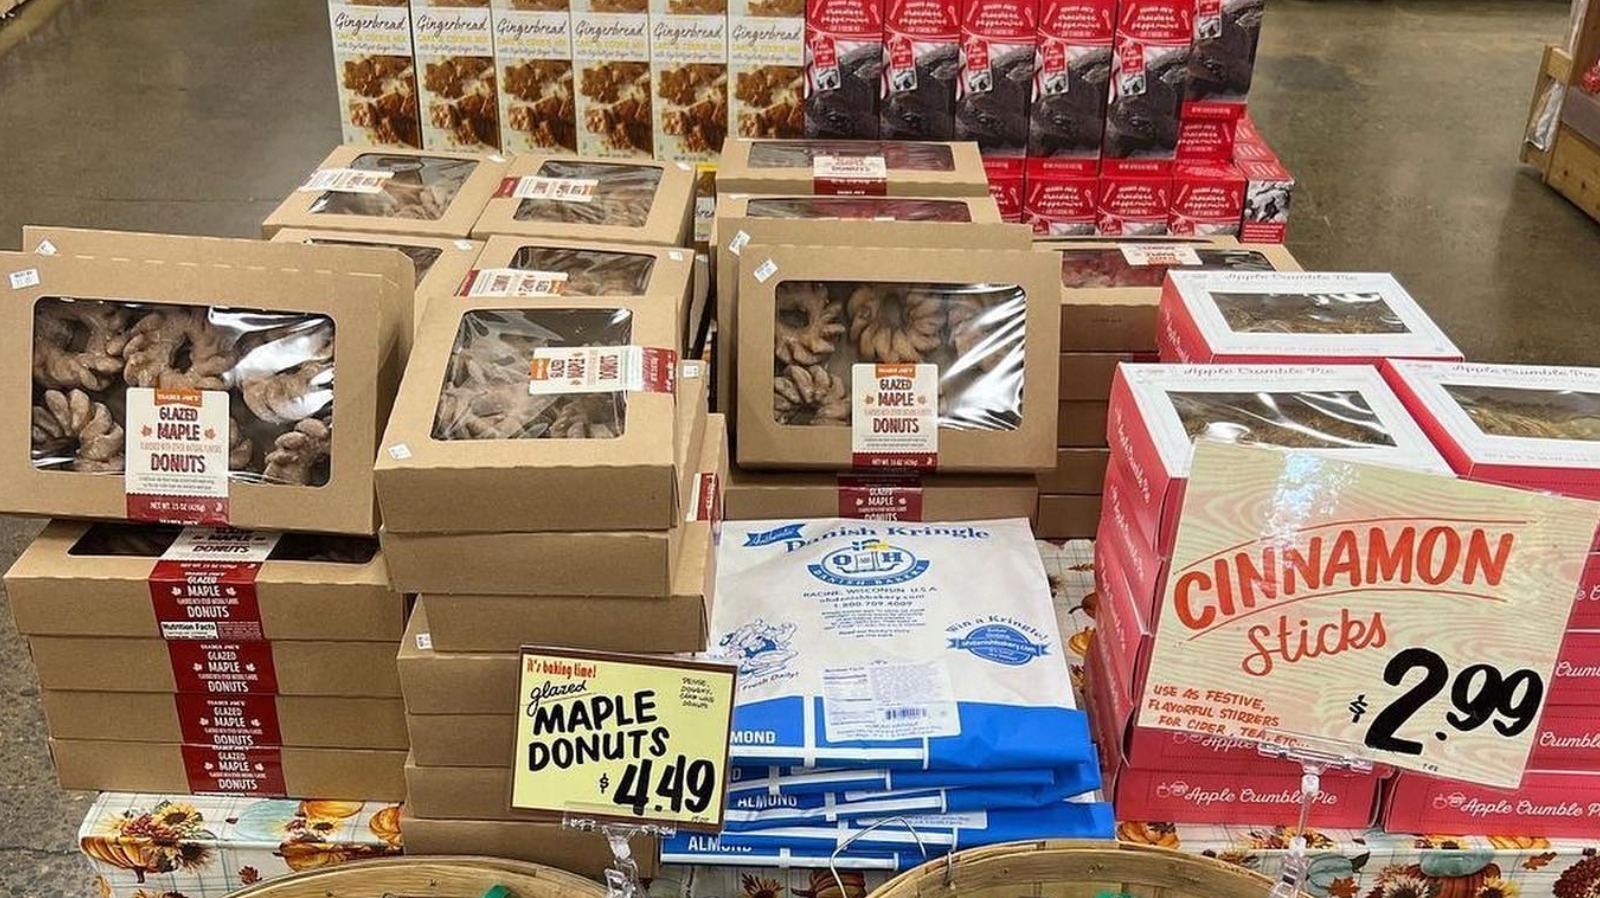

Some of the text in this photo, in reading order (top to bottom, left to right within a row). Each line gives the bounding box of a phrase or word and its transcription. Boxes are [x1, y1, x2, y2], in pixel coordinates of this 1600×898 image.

[335, 12, 406, 36] Gingerbread
[417, 14, 487, 37] Gingerbread
[498, 18, 566, 39] Gingerbread
[575, 20, 646, 42] Gingerbread
[653, 22, 723, 44] Gingerbread
[732, 24, 801, 46] Gingerbread
[879, 379, 913, 391] GLAZED
[878, 392, 914, 406] MAPLE
[159, 407, 198, 421] GLAZED
[157, 423, 201, 441] MAPLE
[873, 417, 920, 433] DONUTS
[151, 453, 206, 473] DONUTS
[868, 497, 894, 506] MAPLE
[785, 527, 991, 553] Danish Kringle
[193, 545, 251, 553] DONUTS
[882, 552, 904, 563] H
[1173, 526, 1514, 629] CINNAMON
[187, 585, 220, 597] MAPLE
[846, 587, 905, 595] WISCONSIN
[187, 605, 230, 618] DONUTS
[162, 623, 216, 631] Nutrition Facts
[945, 620, 972, 632] Win
[988, 614, 1049, 640] Kringle!
[1241, 608, 1386, 677] Sticks
[207, 651, 237, 661] GLAZED
[208, 662, 240, 673] MAPLE
[527, 658, 597, 679] it's baking time!
[1555, 660, 1600, 678] Crum
[208, 681, 249, 693] DONUTS
[527, 680, 587, 717] glazed
[1153, 685, 1267, 713] USE AS FESTIVE,
[213, 706, 243, 716] GLAZED
[533, 690, 657, 735] MAPLE
[1147, 699, 1280, 727] FLAVORFUL STIRRERS
[214, 717, 246, 727] MAPLE
[1158, 715, 1181, 728] FOR
[213, 735, 254, 746] DONUTS
[730, 730, 776, 744] MOND
[218, 752, 246, 761] GLAZED
[528, 726, 670, 771] DONUTS
[218, 761, 250, 772] MAPLE
[218, 779, 258, 790] DONUTS
[1184, 787, 1339, 806] Apple Crumble Pie
[1460, 798, 1513, 817] Apple
[1515, 799, 1584, 818] Crumble
